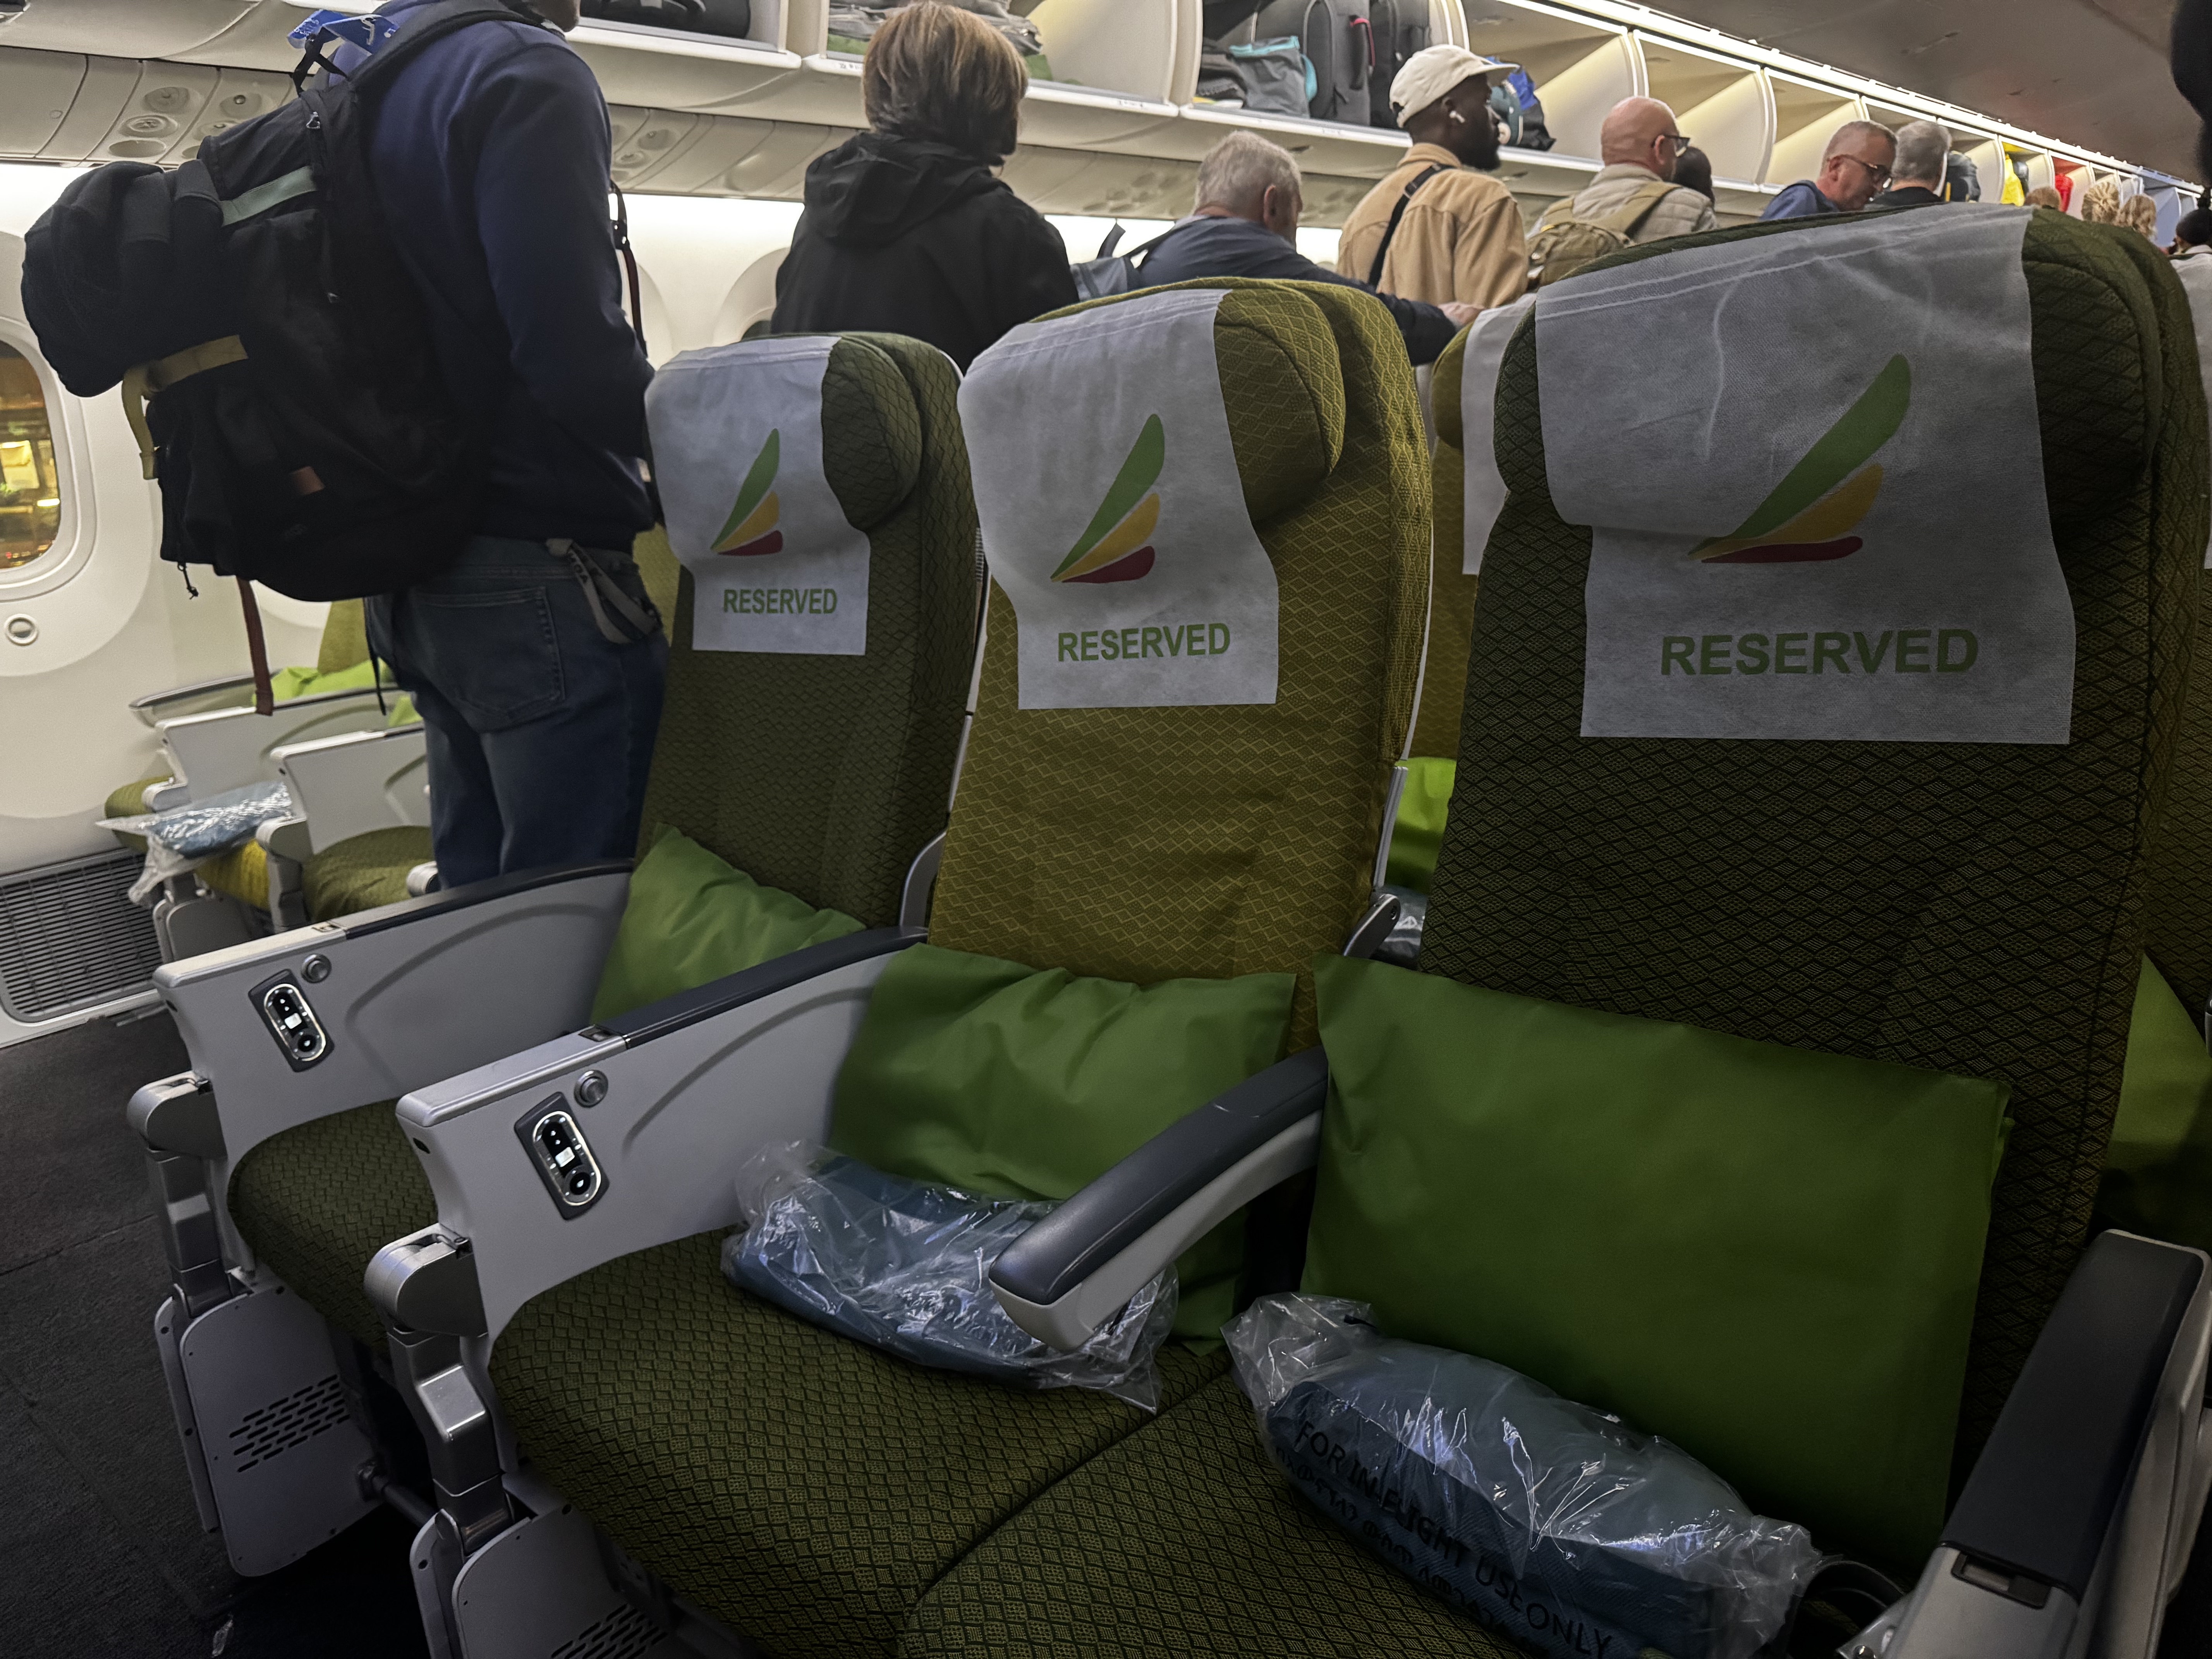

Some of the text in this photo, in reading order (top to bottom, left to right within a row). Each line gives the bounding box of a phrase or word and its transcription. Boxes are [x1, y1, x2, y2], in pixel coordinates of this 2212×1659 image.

[723, 588, 838, 614] RESERVED
[1058, 623, 1231, 661] RESERVED
[1661, 629, 1978, 675] RESERVED
[1294, 1420, 1346, 1474] FOR
[1475, 1554, 1523, 1612] USE
[1527, 1603, 1612, 1659] ONLY
